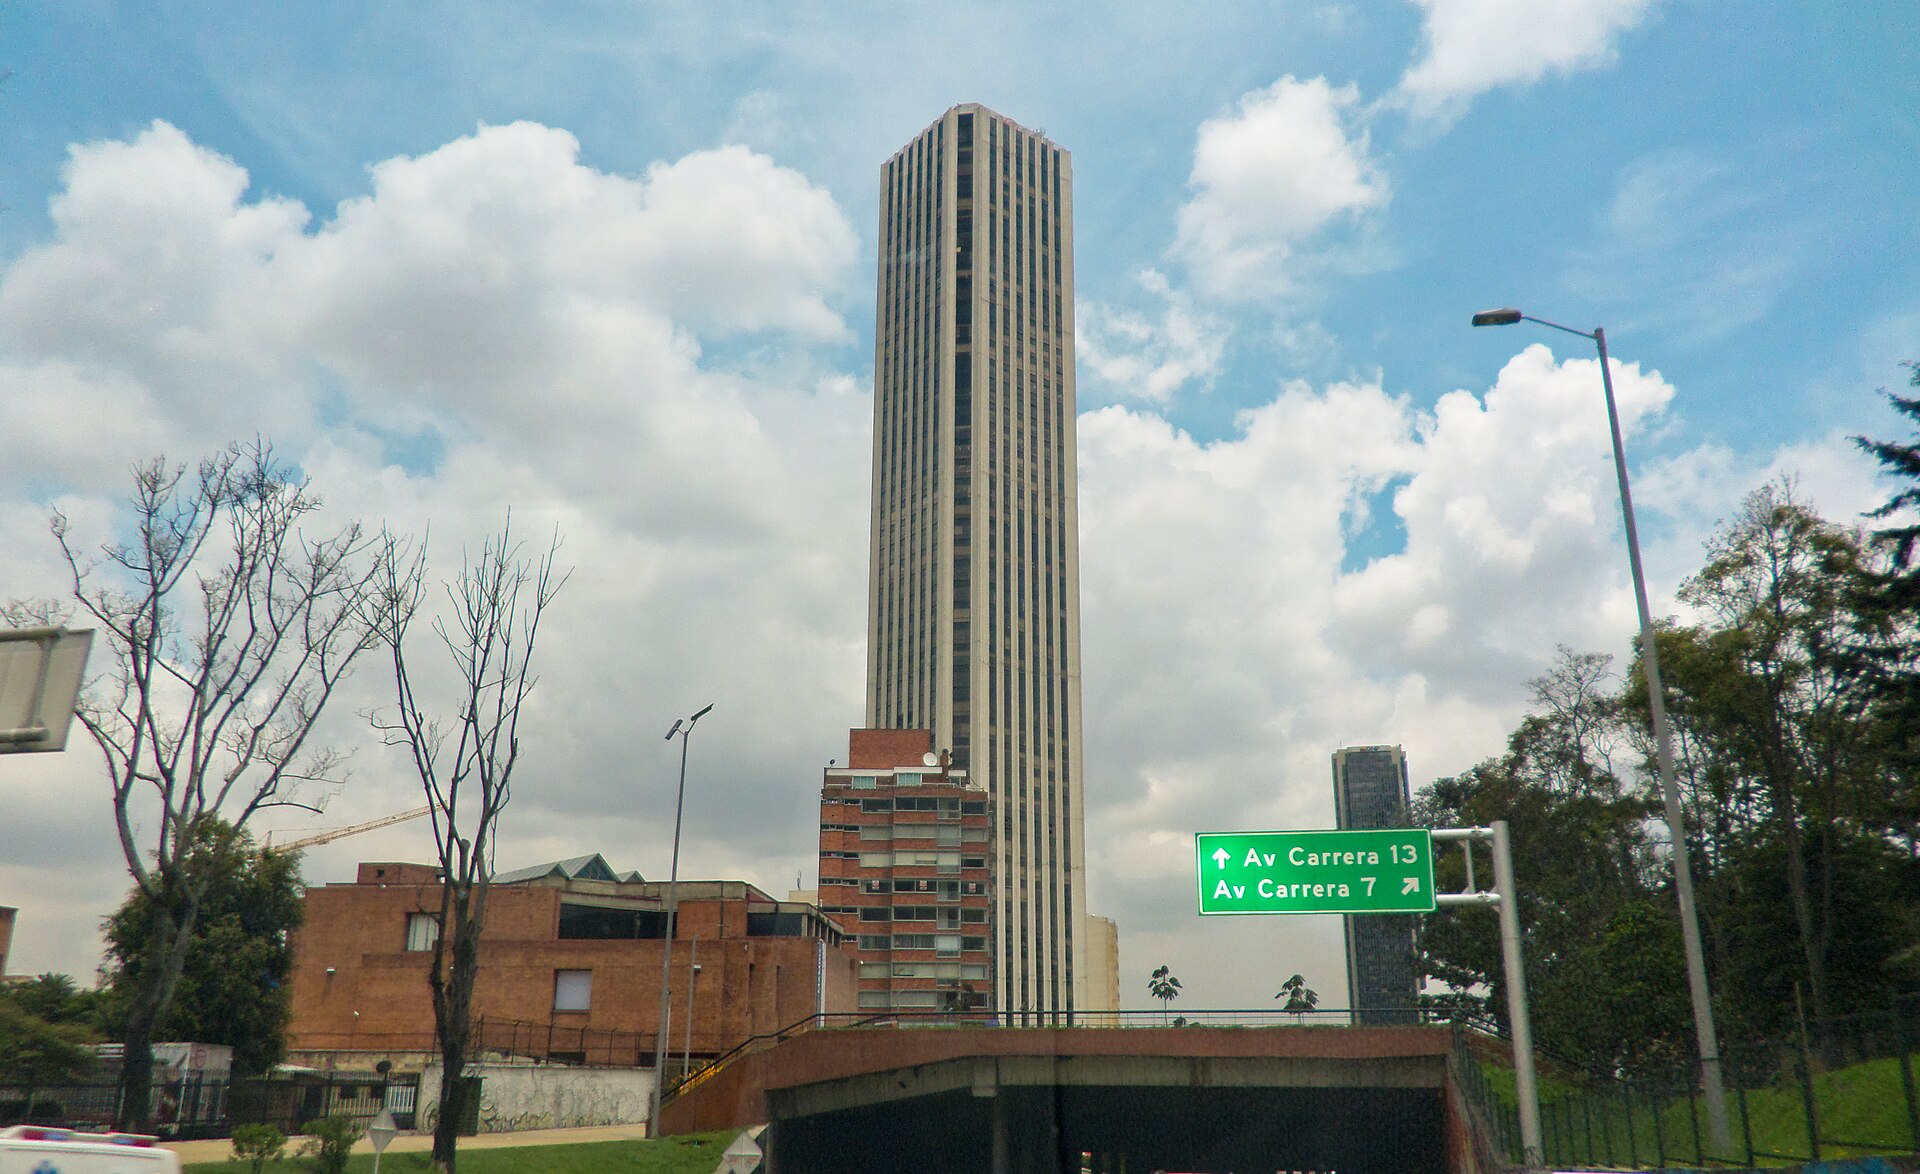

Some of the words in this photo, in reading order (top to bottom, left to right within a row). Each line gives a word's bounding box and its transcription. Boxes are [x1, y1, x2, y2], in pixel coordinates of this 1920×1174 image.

[1243, 847, 1276, 868] Av
[1288, 846, 1379, 866] Carrera
[1390, 844, 1417, 864] 13
[1213, 879, 1245, 899] Av
[1257, 878, 1350, 898] Carrera
[1360, 876, 1376, 897] 7
